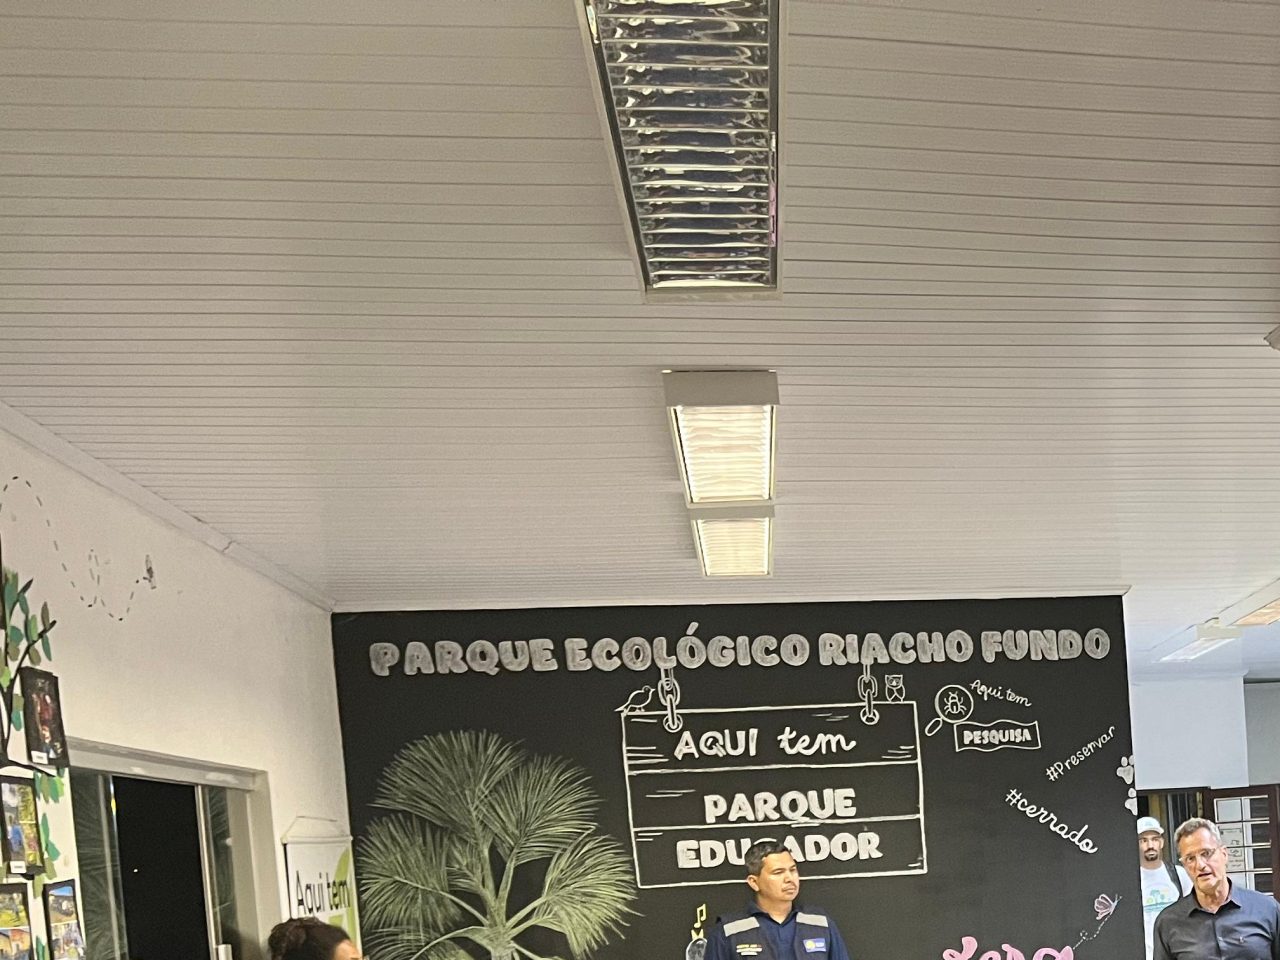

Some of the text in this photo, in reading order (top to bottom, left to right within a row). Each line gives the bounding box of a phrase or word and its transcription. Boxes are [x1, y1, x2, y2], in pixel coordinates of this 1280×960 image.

[368, 621, 1111, 677] PARQUE ECOLÓGICO RIACHO FUNDO
[969, 679, 1033, 708] Aqui tem
[673, 726, 857, 761] AQUI tem
[962, 727, 1033, 745] PESQUISA
[1045, 725, 1116, 782] #Preservar
[703, 787, 857, 824] PARQUE
[1004, 788, 1099, 854] #cerrado
[676, 832, 884, 869] EDUADOR
[295, 870, 351, 917] Aqui tem
